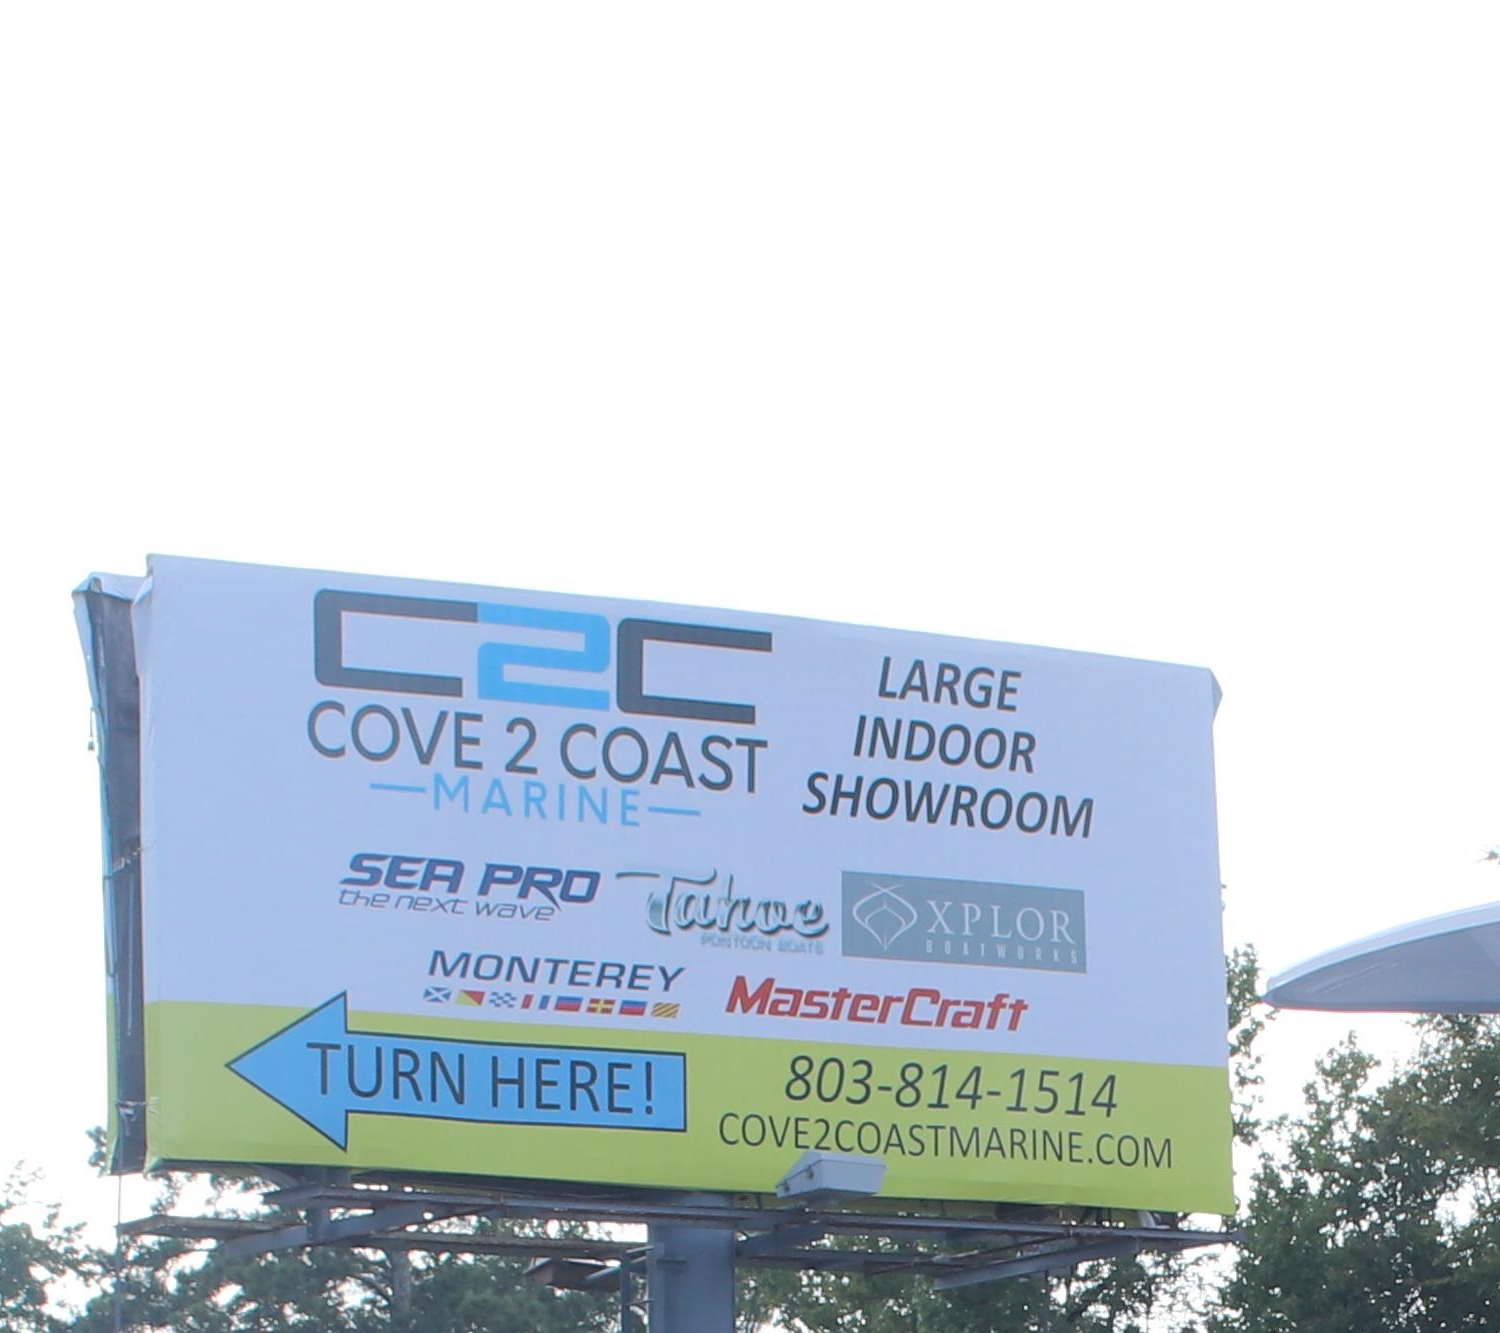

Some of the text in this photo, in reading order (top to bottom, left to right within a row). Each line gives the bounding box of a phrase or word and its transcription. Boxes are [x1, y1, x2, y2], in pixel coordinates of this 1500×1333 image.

[313, 587, 773, 725] C2C
[877, 655, 1022, 712] LARGE
[306, 699, 769, 794] COVE 2 COAST
[853, 714, 1037, 774] INDOOR
[432, 772, 642, 827] MARINE
[801, 770, 1095, 839] SHOWROOM
[338, 888, 558, 922] the next wave
[339, 851, 602, 912] SEA PRO
[615, 868, 830, 937] Tahoe
[925, 938, 1078, 965] BOATWORKS
[926, 899, 1077, 945] XPLOR
[427, 949, 686, 993] MONTEREY
[724, 974, 1029, 1032] MasterCraft
[306, 1041, 655, 1115] TURN HERE!
[784, 1054, 1119, 1119] 803-814-1514
[717, 1111, 1174, 1169] COVE2COASTMARINE.COM
